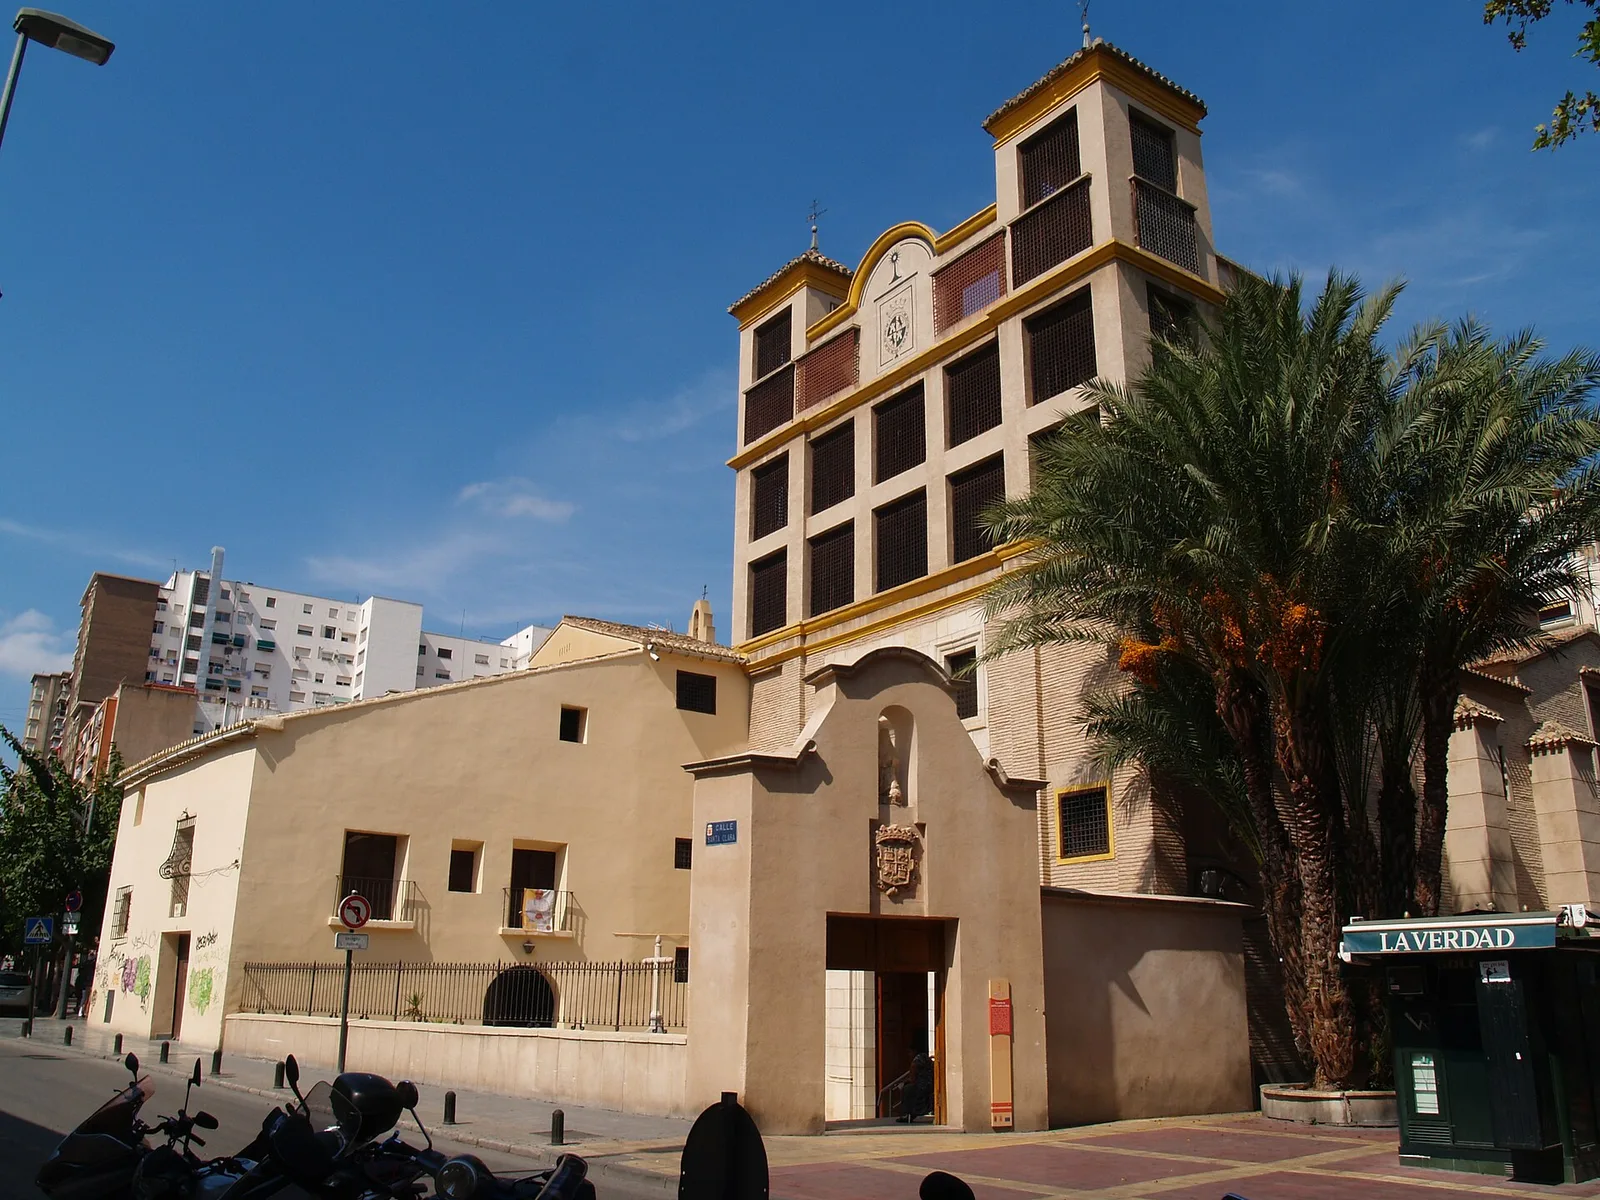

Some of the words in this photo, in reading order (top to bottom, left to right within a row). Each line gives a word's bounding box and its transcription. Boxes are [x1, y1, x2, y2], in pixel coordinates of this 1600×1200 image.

[715, 823, 734, 831] CALLE
[1380, 932, 1411, 952] LA
[1411, 929, 1515, 950] VERDAD
